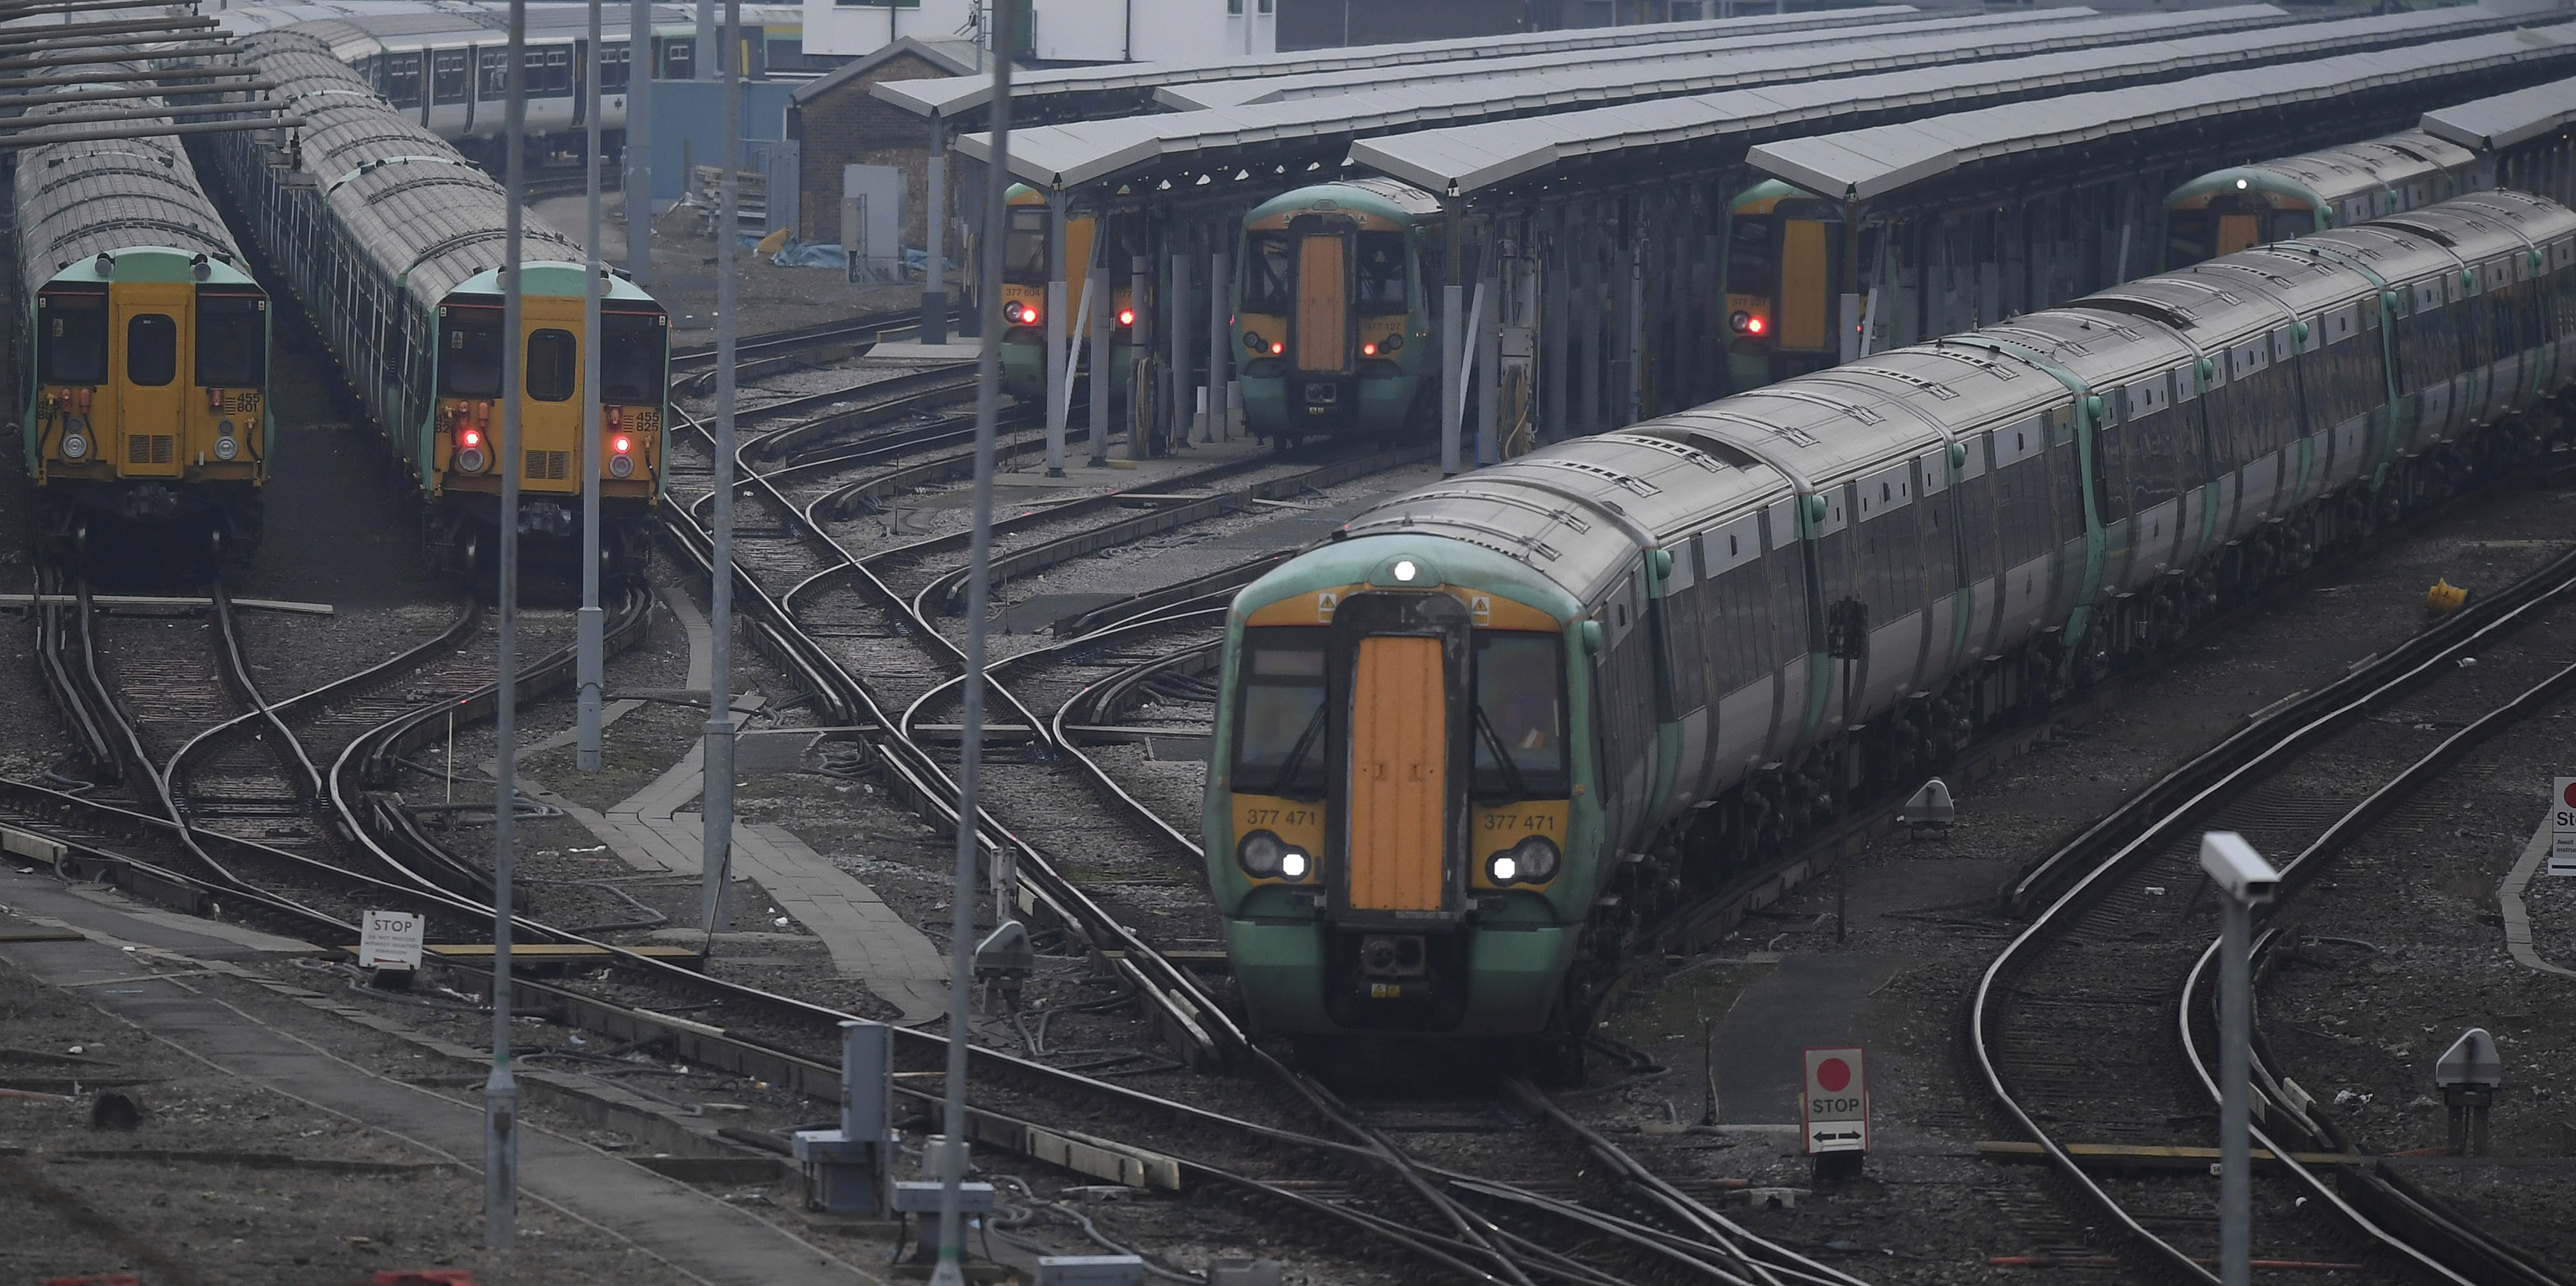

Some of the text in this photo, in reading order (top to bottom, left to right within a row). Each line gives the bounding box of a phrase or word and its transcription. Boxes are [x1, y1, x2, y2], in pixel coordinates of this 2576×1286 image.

[1006, 288, 1021, 296] 377
[238, 393, 261, 403] 455
[238, 402, 258, 413] 801
[637, 412, 660, 421] 455
[637, 421, 659, 432] 825
[1247, 809, 1314, 826] 377 471
[1484, 814, 1553, 830] 377 471
[2557, 812, 2576, 826] St
[375, 920, 413, 932] STOP
[1813, 1098, 1859, 1113] STOP
